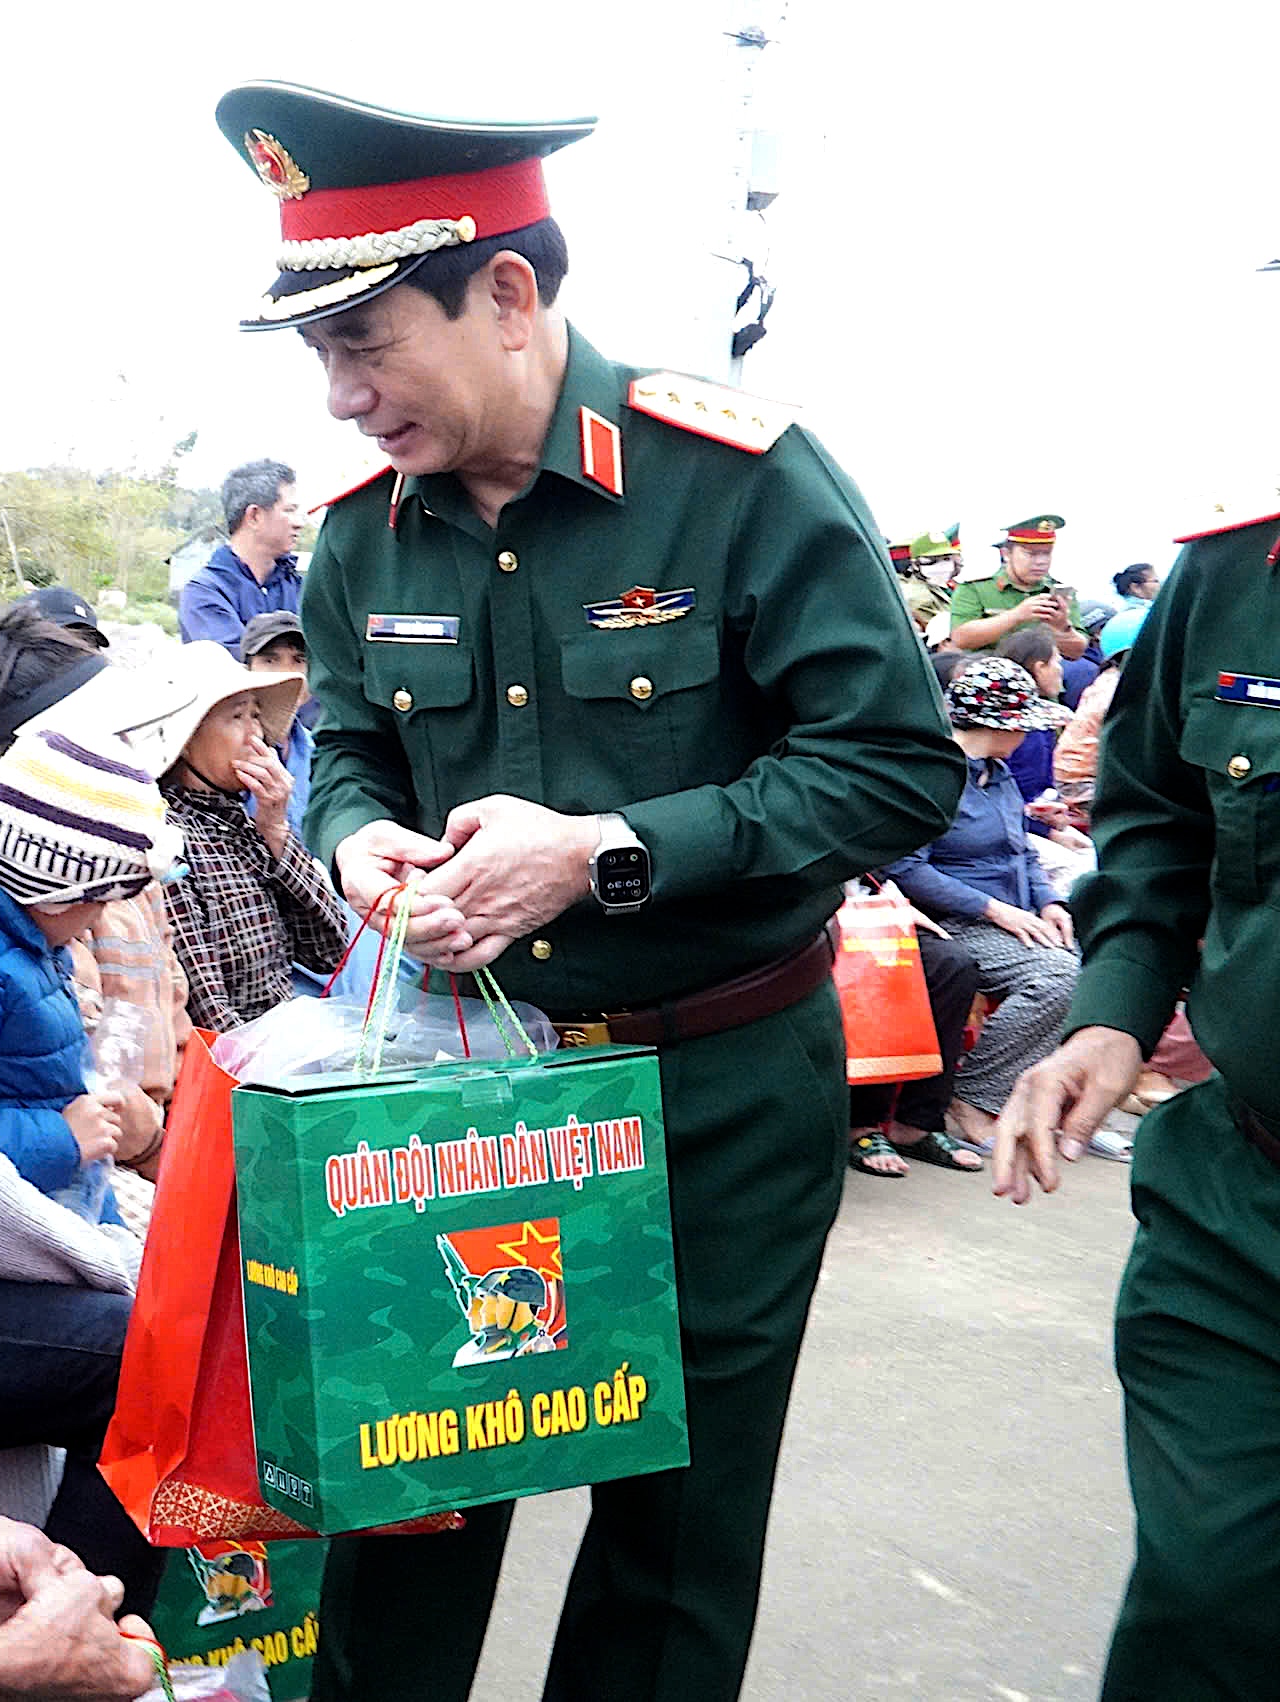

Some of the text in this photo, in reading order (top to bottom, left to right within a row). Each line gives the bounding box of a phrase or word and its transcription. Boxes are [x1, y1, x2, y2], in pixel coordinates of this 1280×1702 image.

[326, 1114, 645, 1217] QUÂN ĐỘI NHÂN DÂN VIỆT NAM
[360, 1360, 647, 1469] LƯƠNG KHÔ CAO CẤP
